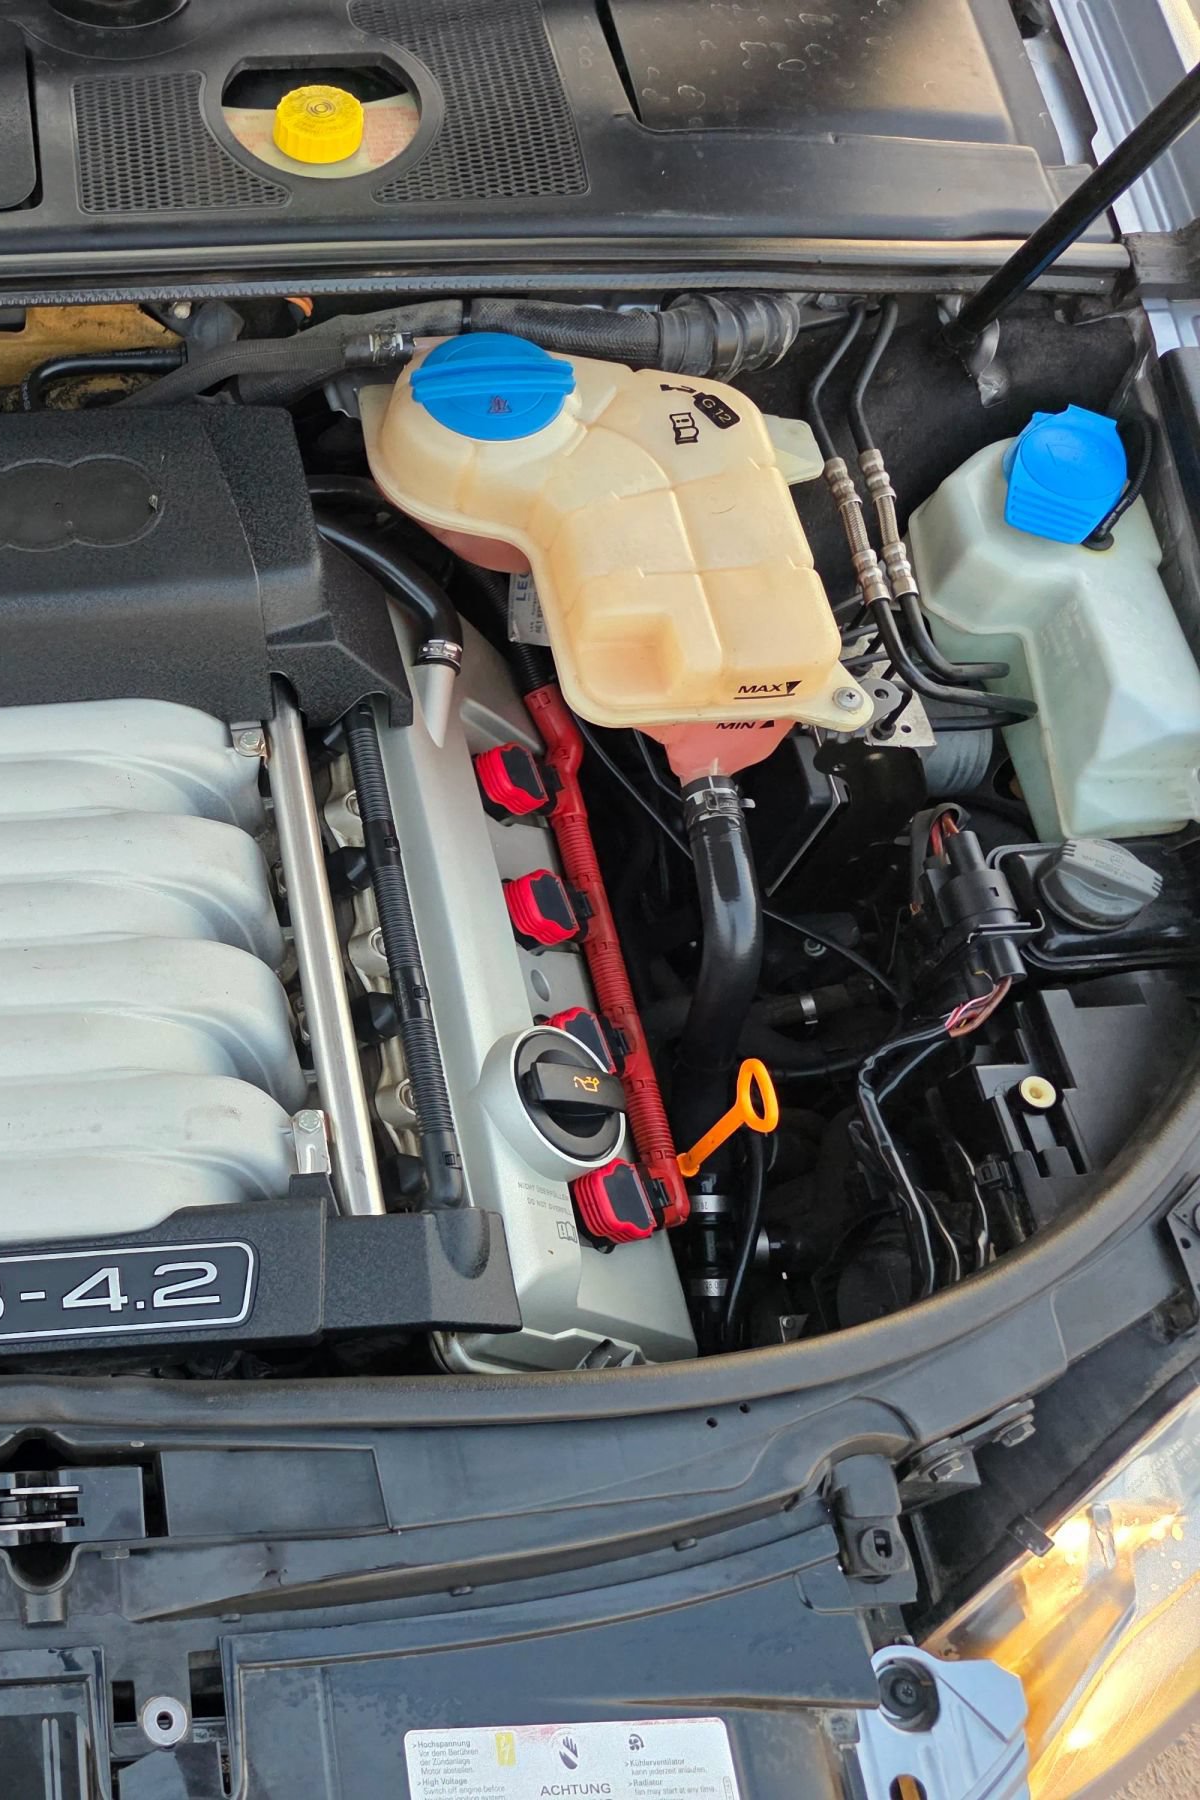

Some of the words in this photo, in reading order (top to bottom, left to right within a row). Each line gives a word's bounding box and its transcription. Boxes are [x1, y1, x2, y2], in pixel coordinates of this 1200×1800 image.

[702, 398, 716, 409] G
[715, 408, 732, 423] 12
[738, 683, 783, 694] MAX
[716, 721, 756, 730] MIN
[417, 1740, 471, 1749] Hochspannung
[422, 1779, 439, 1787] High
[442, 1778, 468, 1786] Voltage
[633, 1778, 662, 1787] Radiator
[540, 1783, 611, 1796] ACHTUNG
